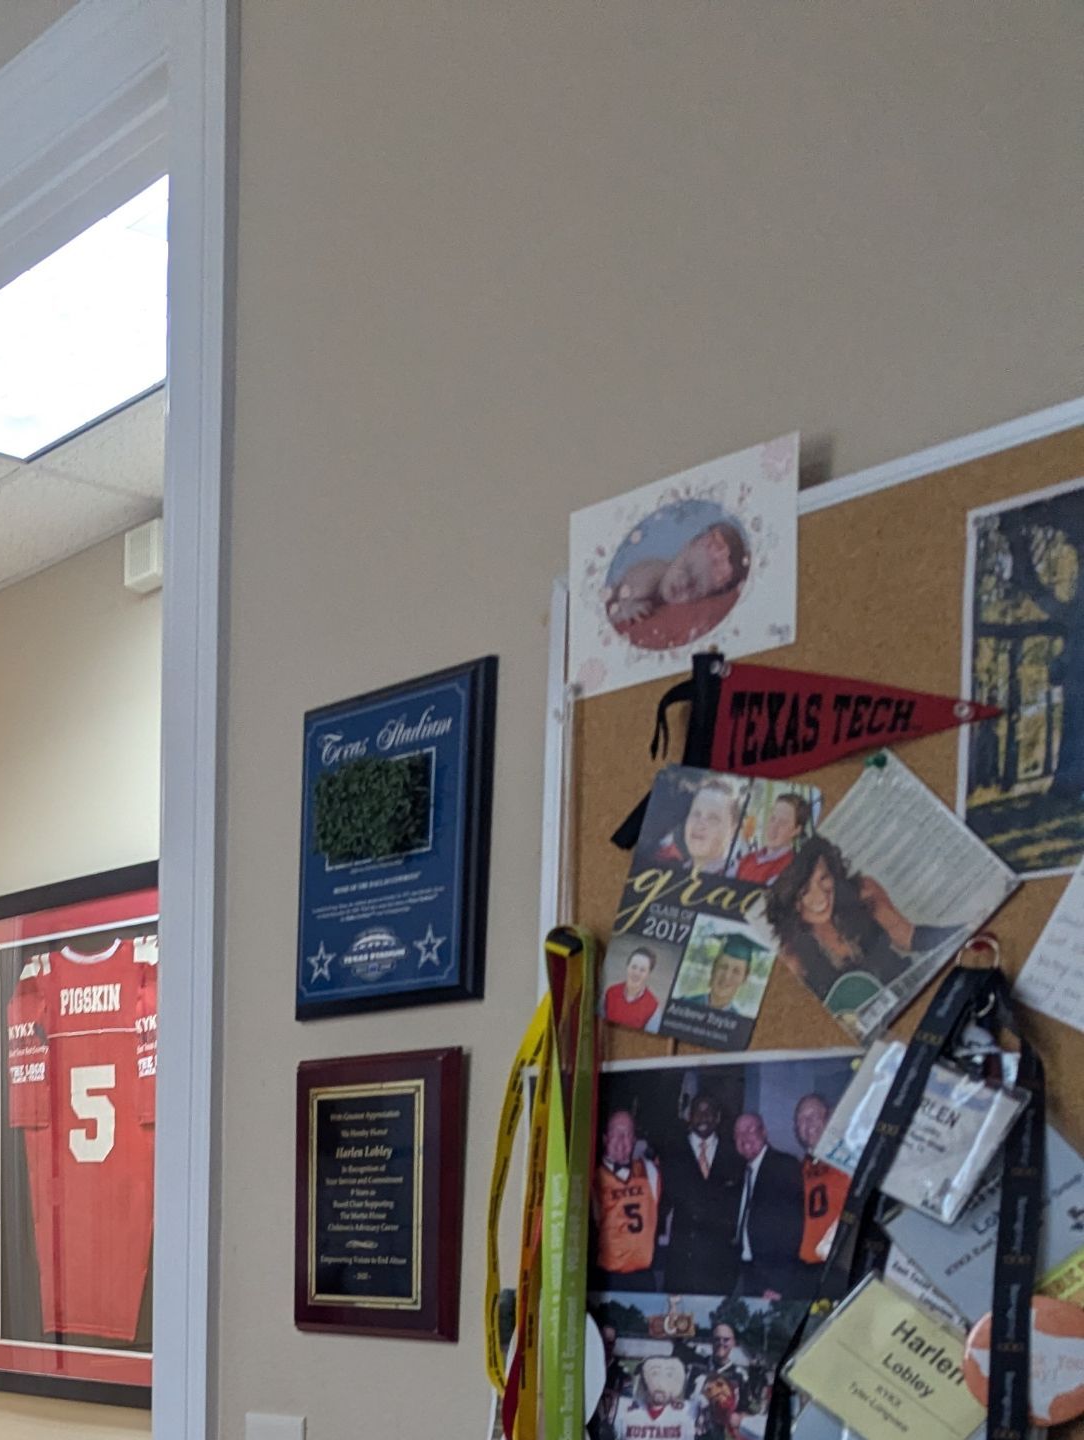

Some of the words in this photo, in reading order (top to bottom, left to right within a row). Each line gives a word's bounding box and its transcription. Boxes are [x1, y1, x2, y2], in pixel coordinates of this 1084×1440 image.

[376, 705, 454, 751] Stadium
[727, 690, 823, 770] TEXAS
[832, 694, 915, 745] TECH
[649, 903, 677, 918] CLASS
[680, 909, 695, 920] OF
[641, 917, 692, 945] 2017
[60, 983, 122, 1016] PIGSKIN
[8, 1021, 35, 1041] KYKX
[69, 1064, 116, 1163] 5
[336, 1146, 363, 1159] Harlen
[365, 1145, 393, 1160] Lobley
[624, 1202, 644, 1234] 5
[808, 1183, 829, 1220] 0
[890, 1319, 966, 1386] Harlen
[882, 1352, 935, 1398] Lobley
